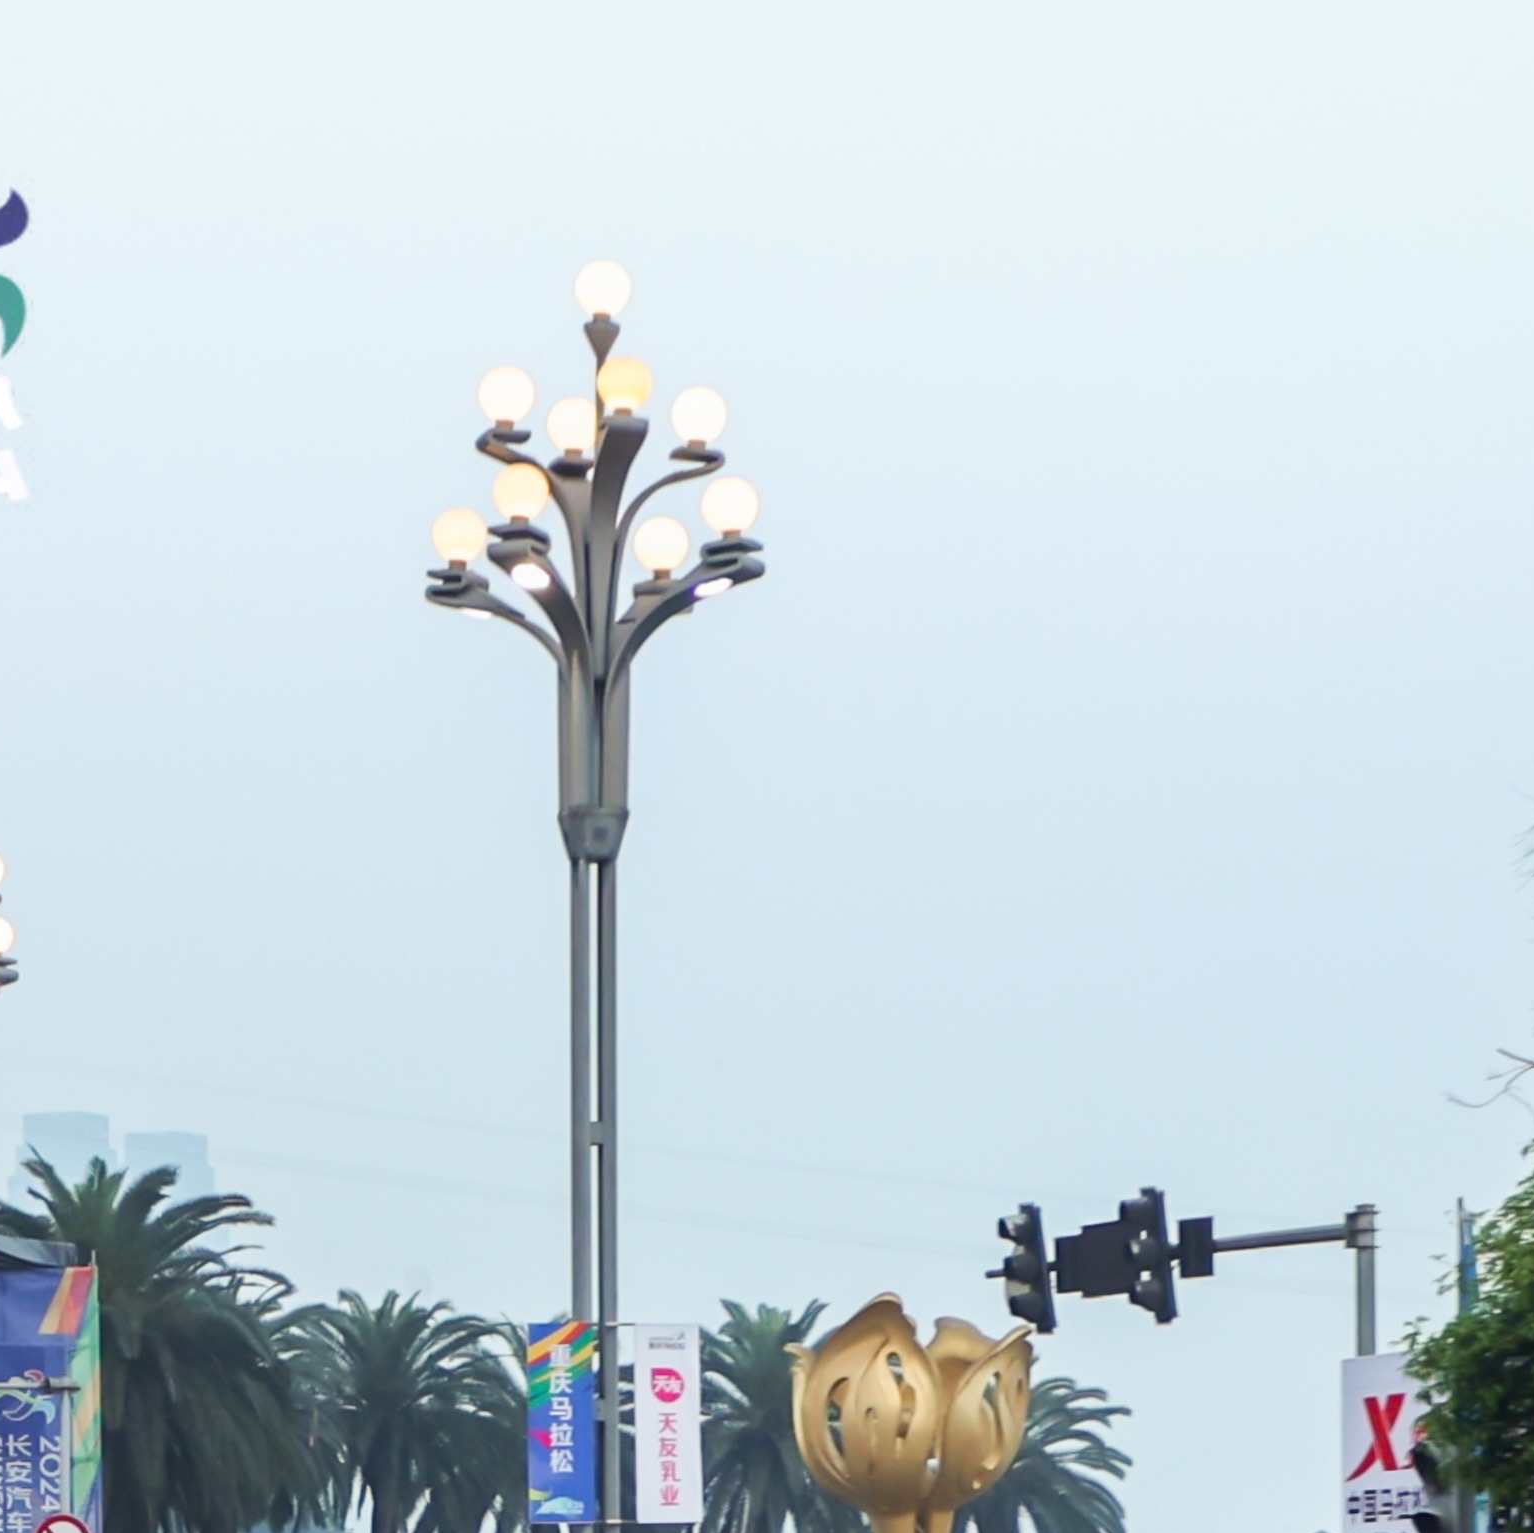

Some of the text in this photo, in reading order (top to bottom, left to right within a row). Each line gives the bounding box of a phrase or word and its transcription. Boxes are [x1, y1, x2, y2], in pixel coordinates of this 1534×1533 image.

[548, 1343, 575, 1474] 重庆马拉松
[39, 1436, 61, 1512] 2024
[658, 1412, 682, 1507] 天友乳业
